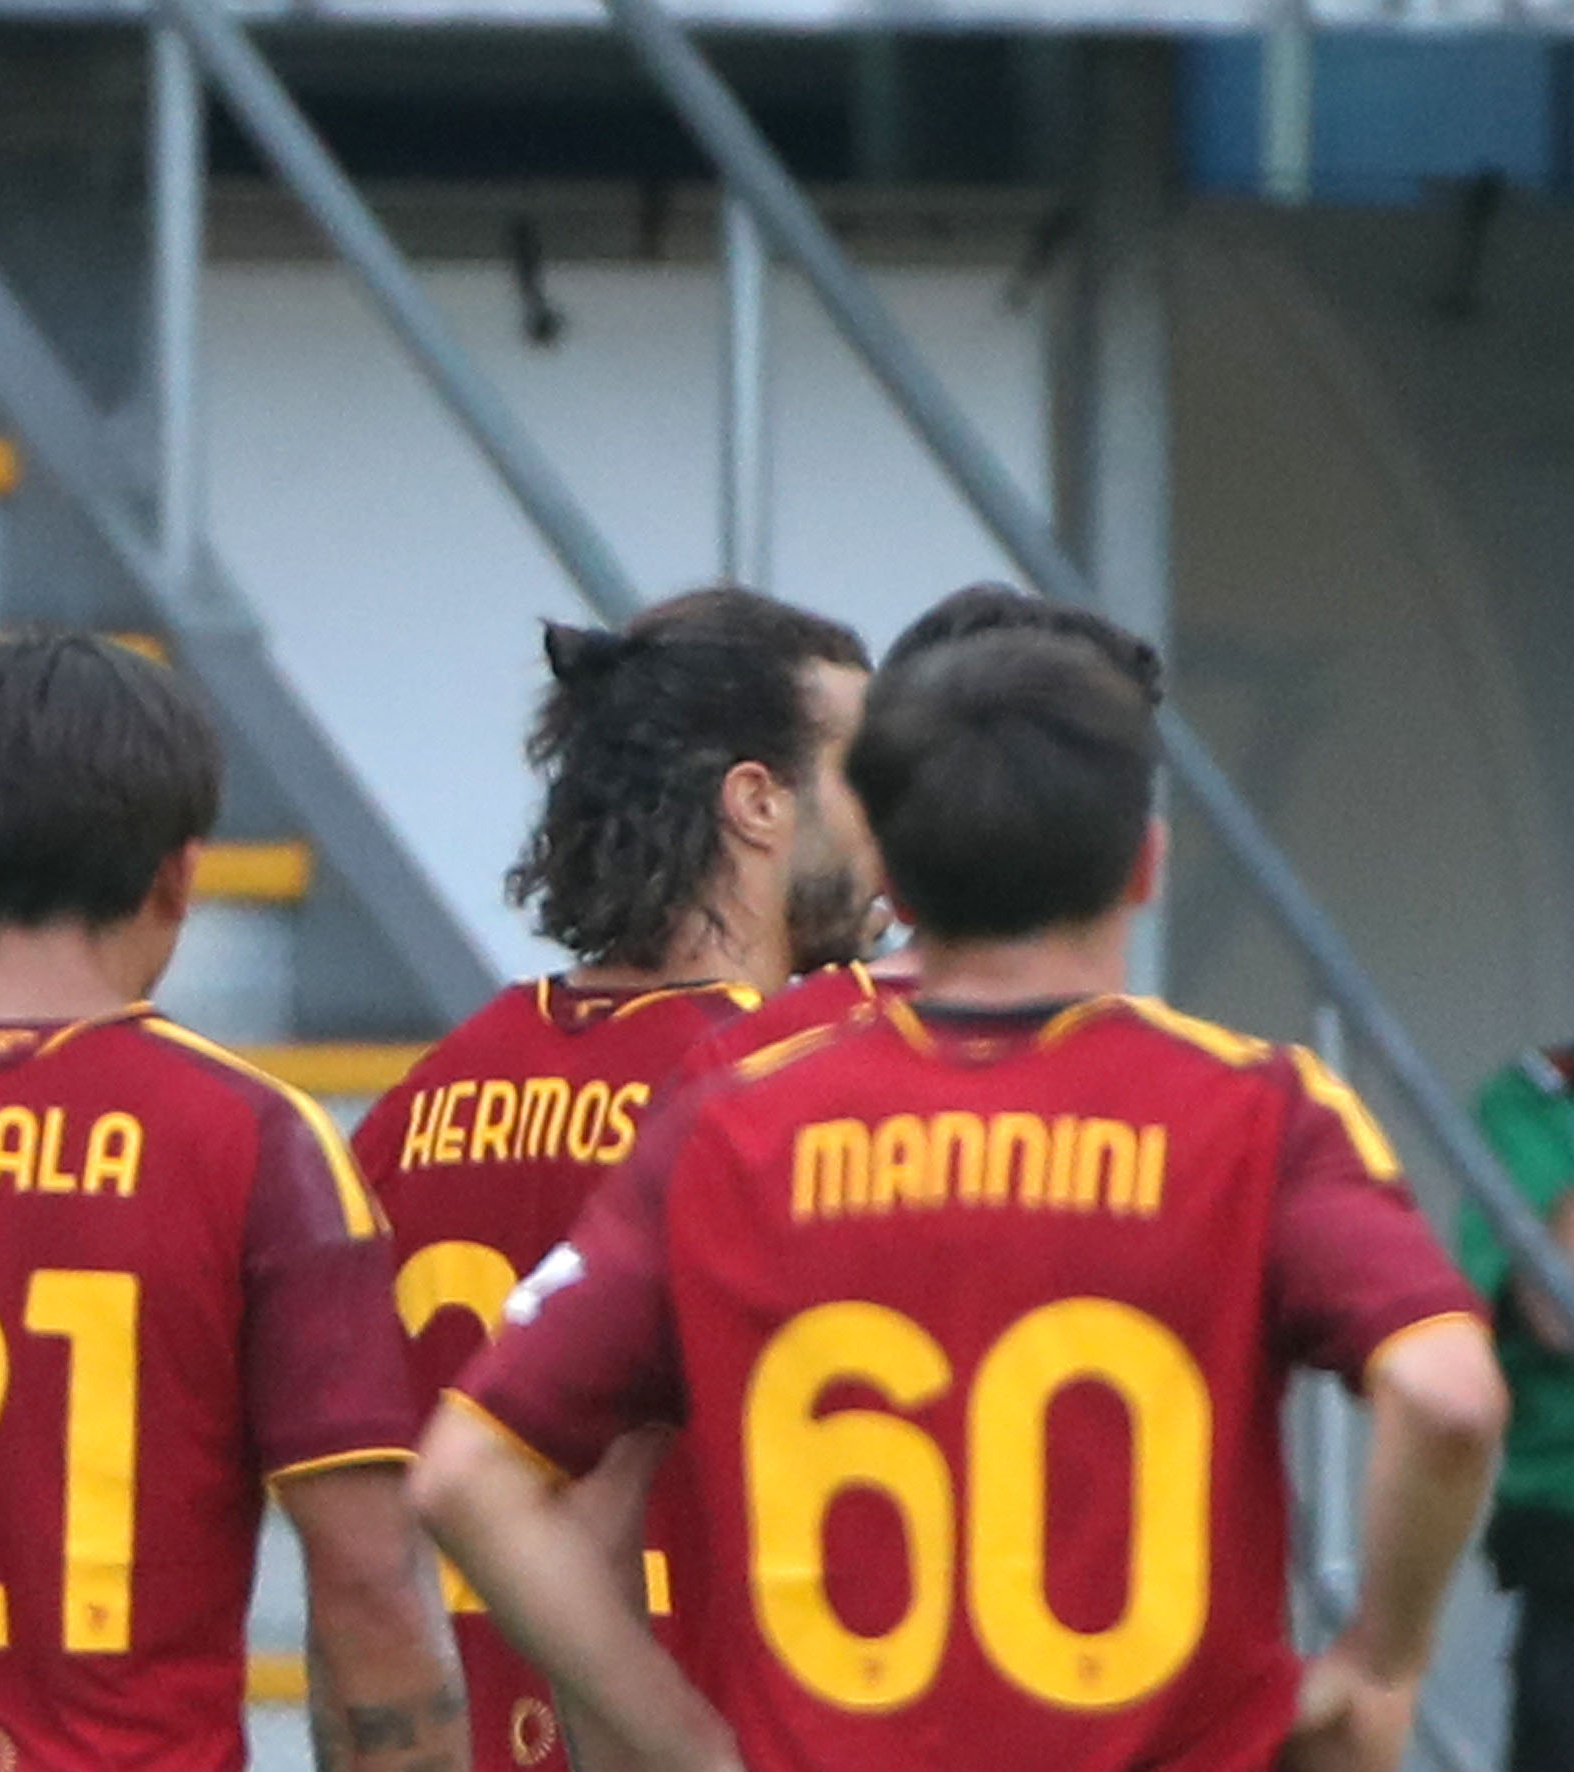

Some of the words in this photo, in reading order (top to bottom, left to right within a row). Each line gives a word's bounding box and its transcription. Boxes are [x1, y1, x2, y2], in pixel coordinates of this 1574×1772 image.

[399, 1076, 651, 1171] HERMOS
[790, 1112, 1166, 1221] MANNINI
[742, 1296, 1213, 1712] 60
